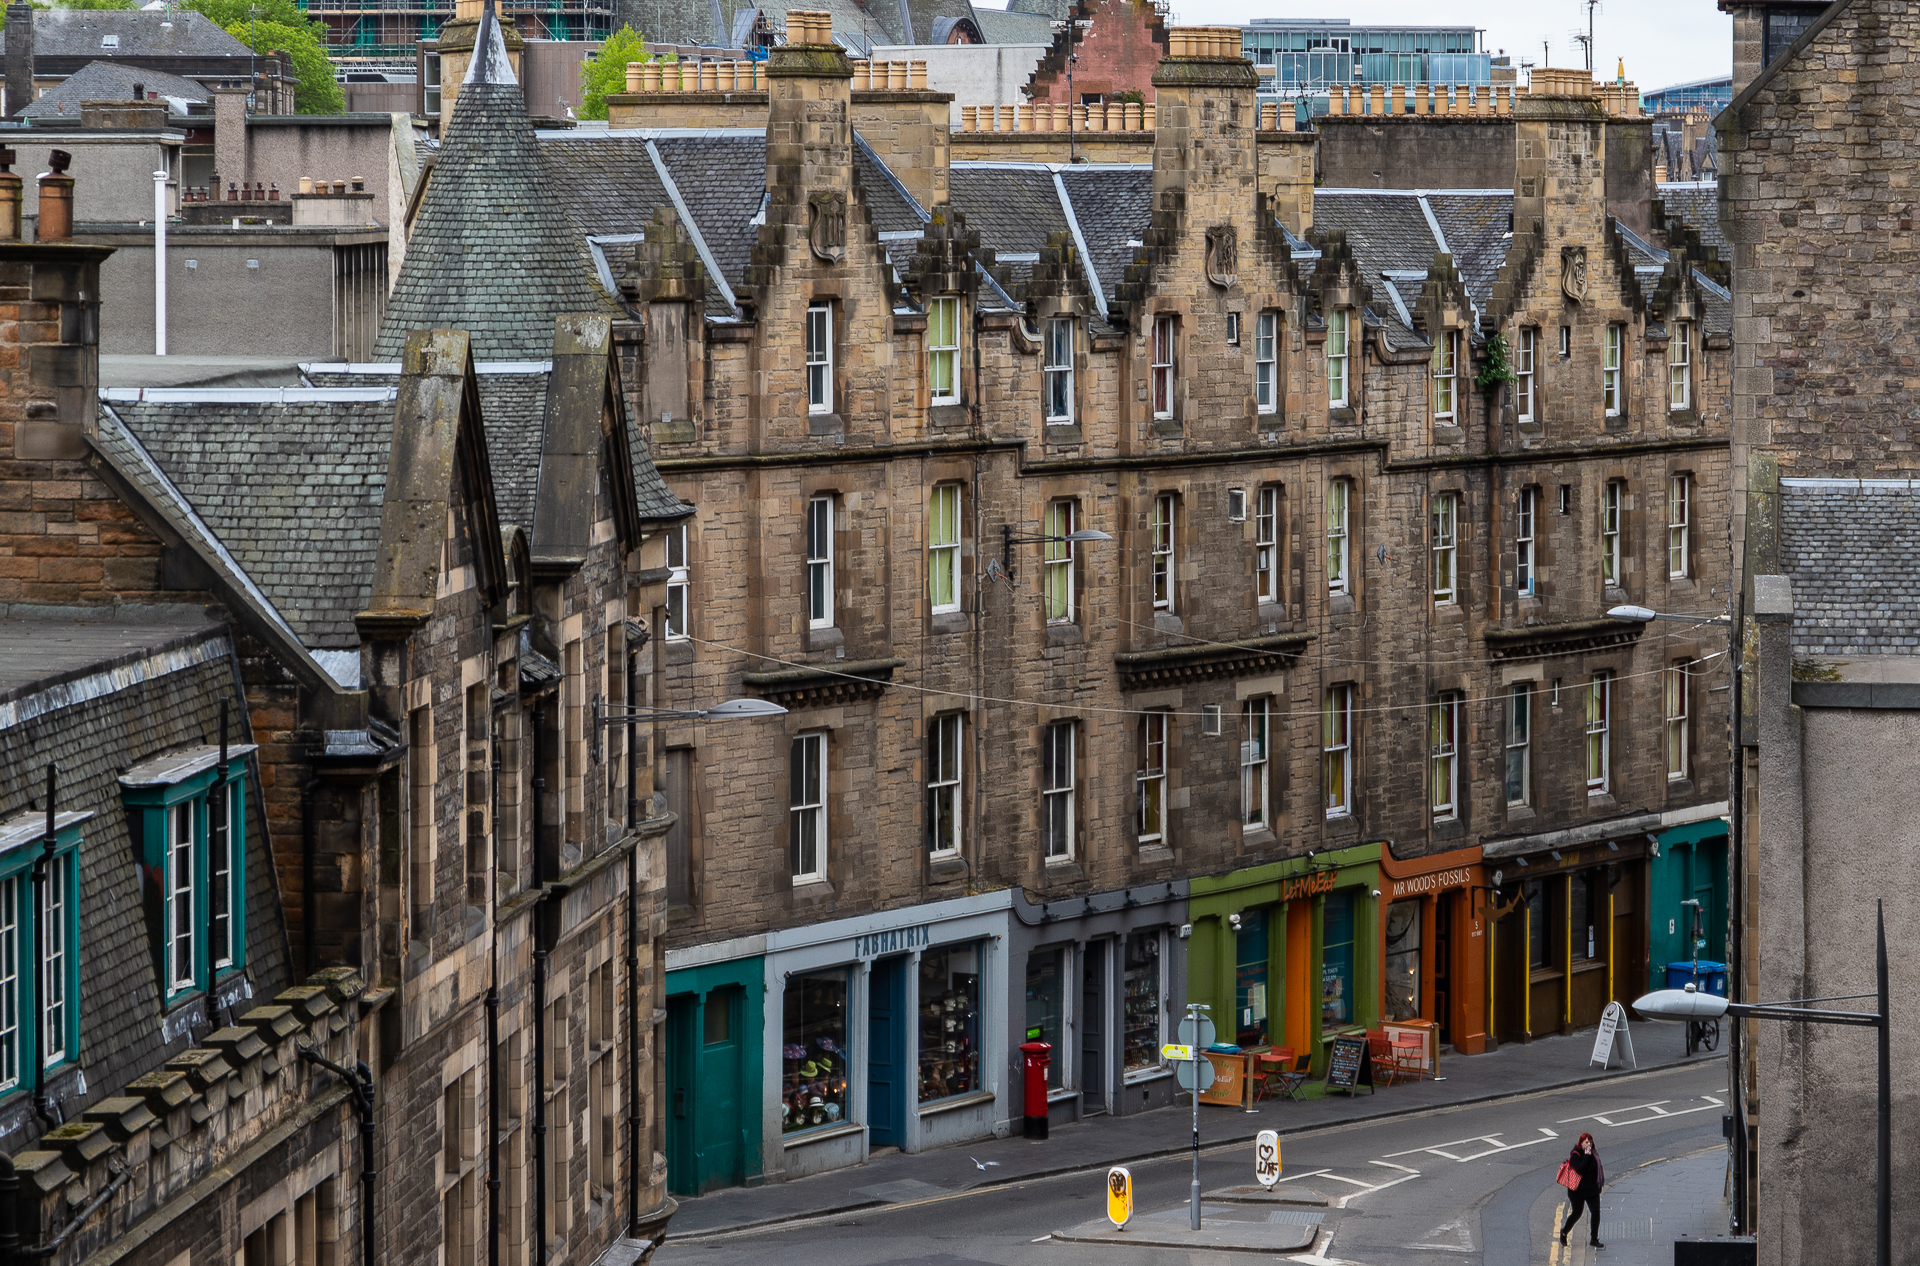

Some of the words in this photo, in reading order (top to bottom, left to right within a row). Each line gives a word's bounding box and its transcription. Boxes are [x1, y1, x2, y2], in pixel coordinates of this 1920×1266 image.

[1393, 881, 1406, 896] MR
[1406, 874, 1436, 893] WOOD'S
[1438, 867, 1470, 887] FOSSILS
[855, 924, 930, 958] FABHATRIX
[1212, 1060, 1234, 1072] ALTHY
[1206, 1089, 1230, 1098] ATING
